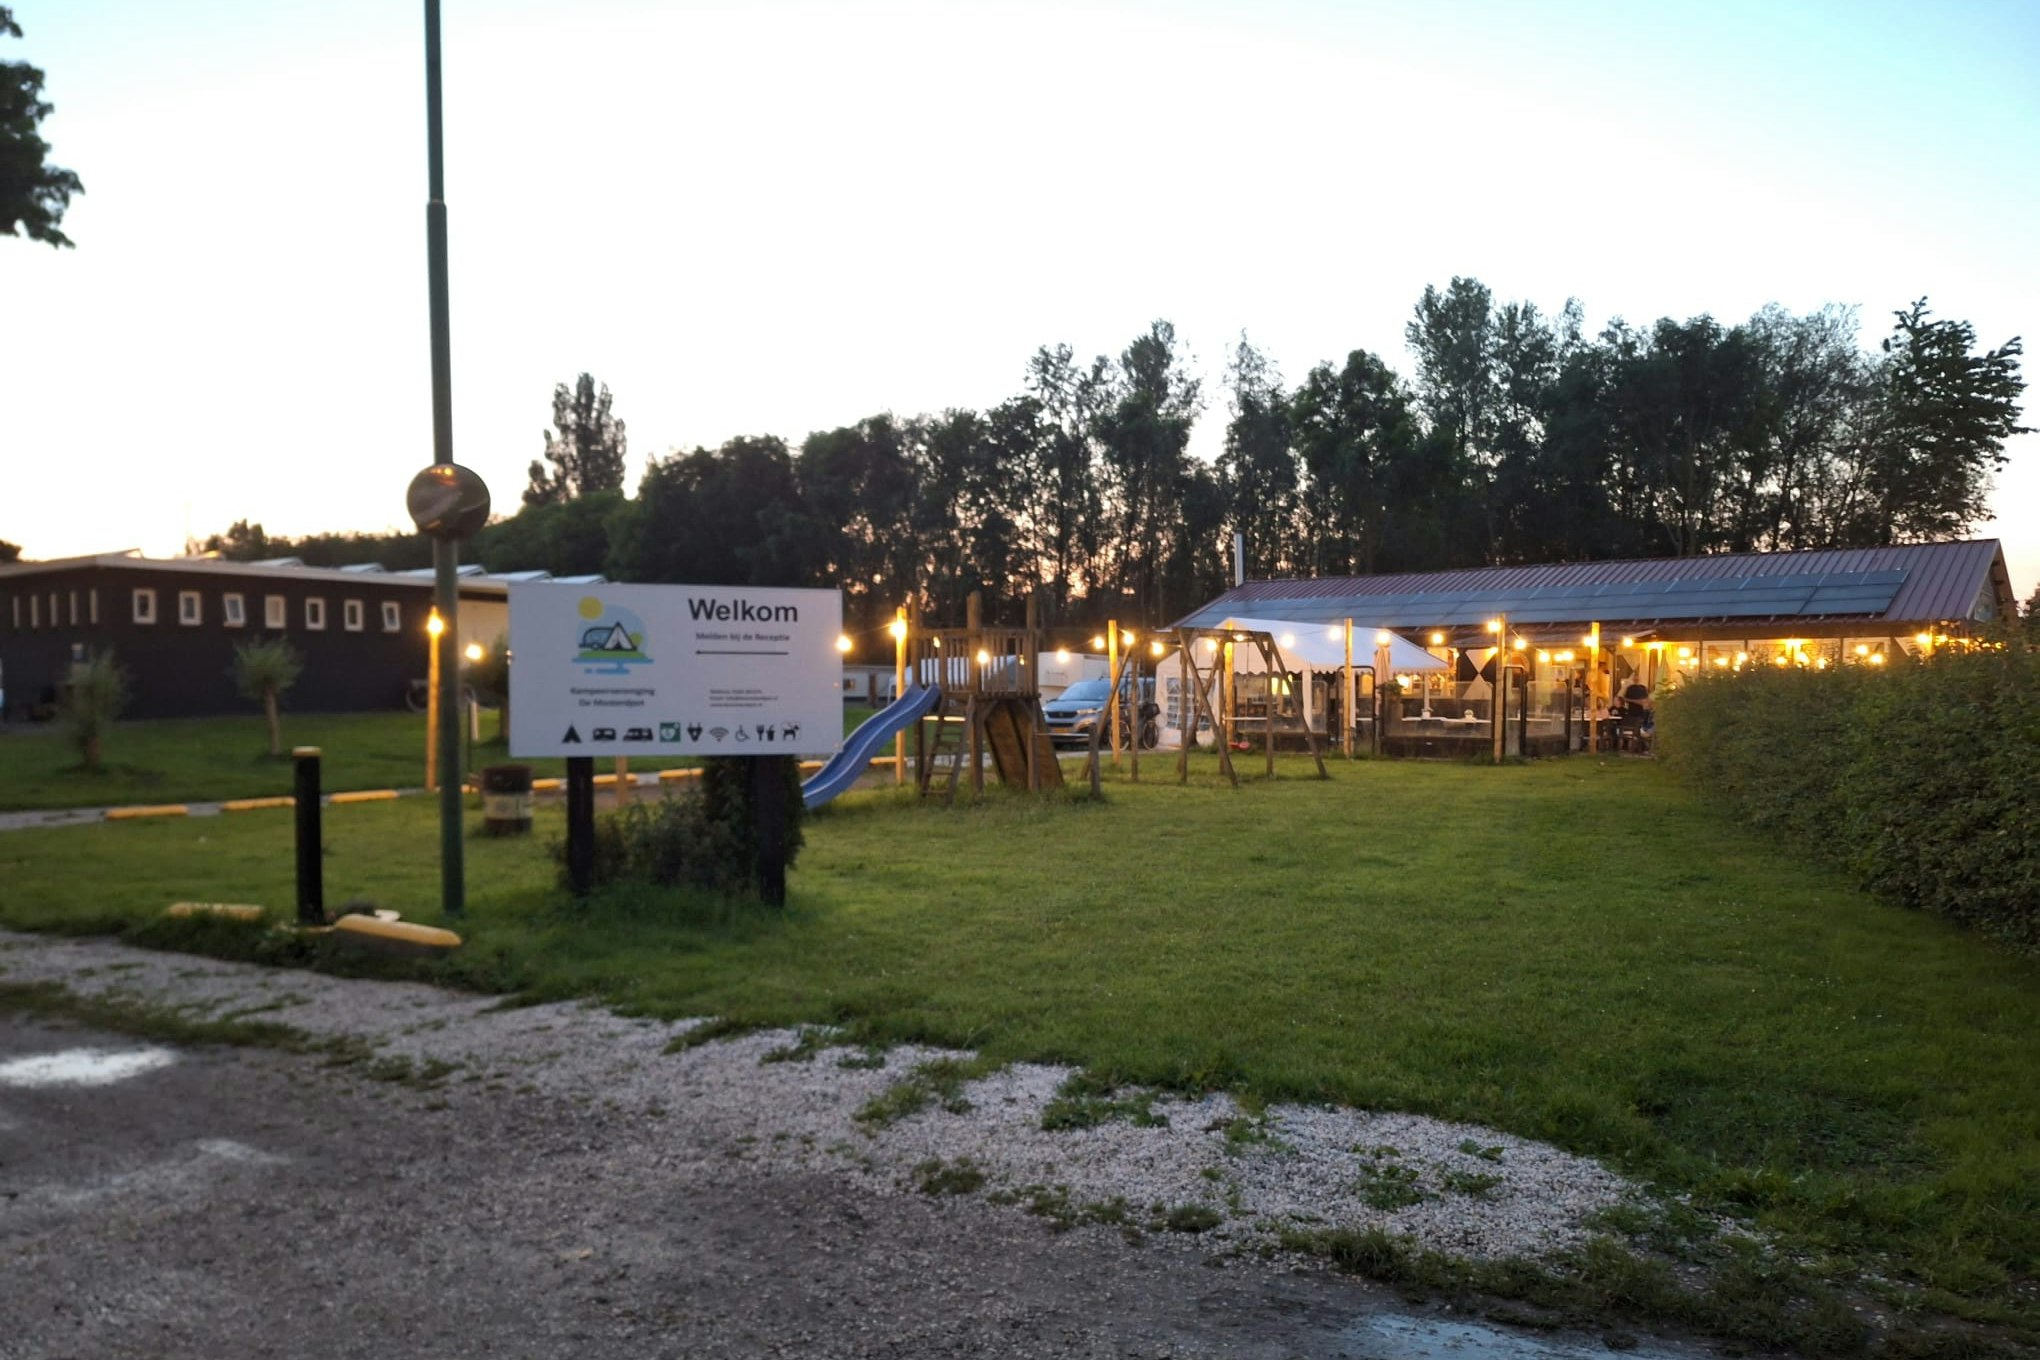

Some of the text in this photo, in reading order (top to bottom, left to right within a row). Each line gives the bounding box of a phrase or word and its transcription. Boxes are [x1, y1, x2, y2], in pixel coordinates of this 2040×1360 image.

[688, 598, 798, 622] Welkom
[695, 632, 790, 643] Melden bij de Receptie
